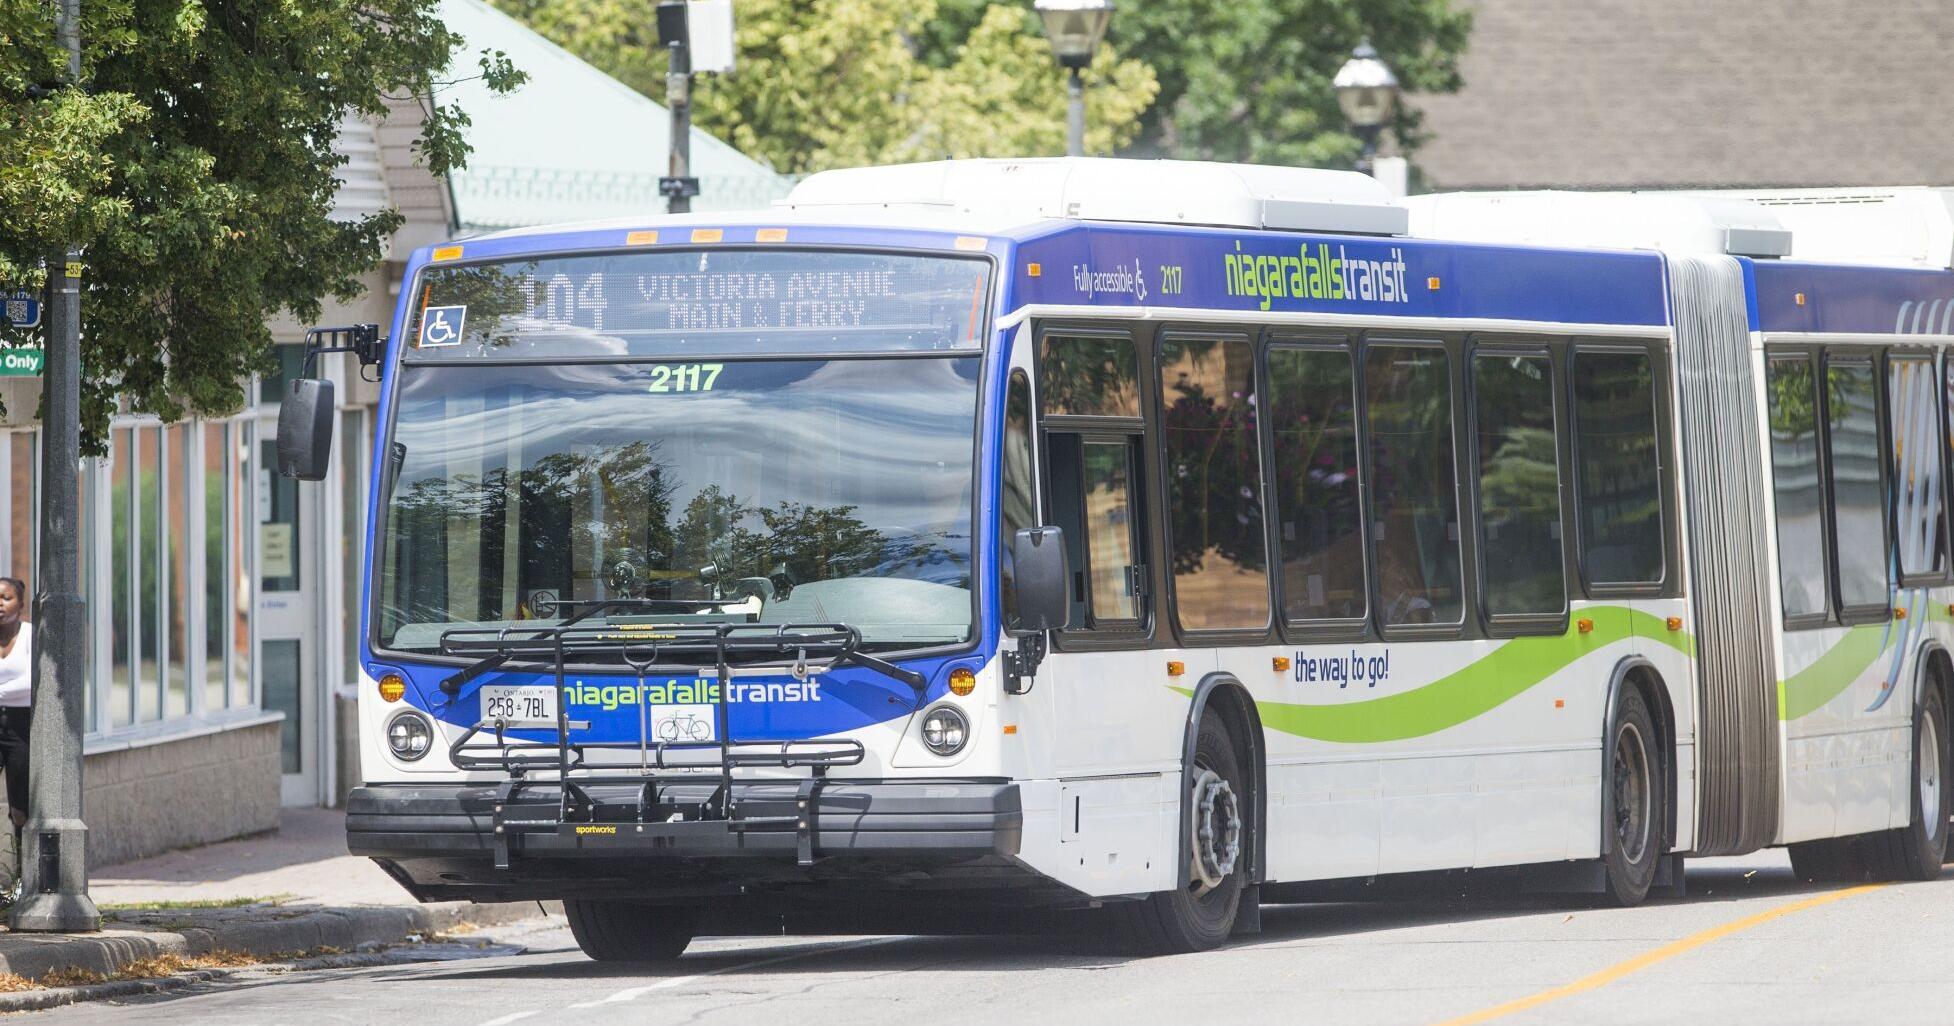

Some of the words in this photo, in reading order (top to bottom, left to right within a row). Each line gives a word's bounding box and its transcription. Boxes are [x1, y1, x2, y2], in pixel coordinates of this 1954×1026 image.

[70, 264, 79, 275] 53
[1073, 263, 1093, 299] Fully
[1094, 264, 1133, 293] accessible
[1160, 265, 1182, 294] 2117
[638, 273, 775, 301] VICTORIA
[788, 270, 896, 298] AVENUE
[518, 273, 608, 331] 104
[670, 302, 742, 329] MAIN
[754, 302, 768, 328] &
[780, 300, 865, 328] FERRY
[5, 354, 39, 371] Only
[648, 363, 723, 393] 2117
[1295, 651, 1317, 682] the
[1319, 657, 1348, 689] way
[1352, 649, 1365, 681] to
[1368, 648, 1389, 688] go!
[575, 826, 617, 835] sportworks
